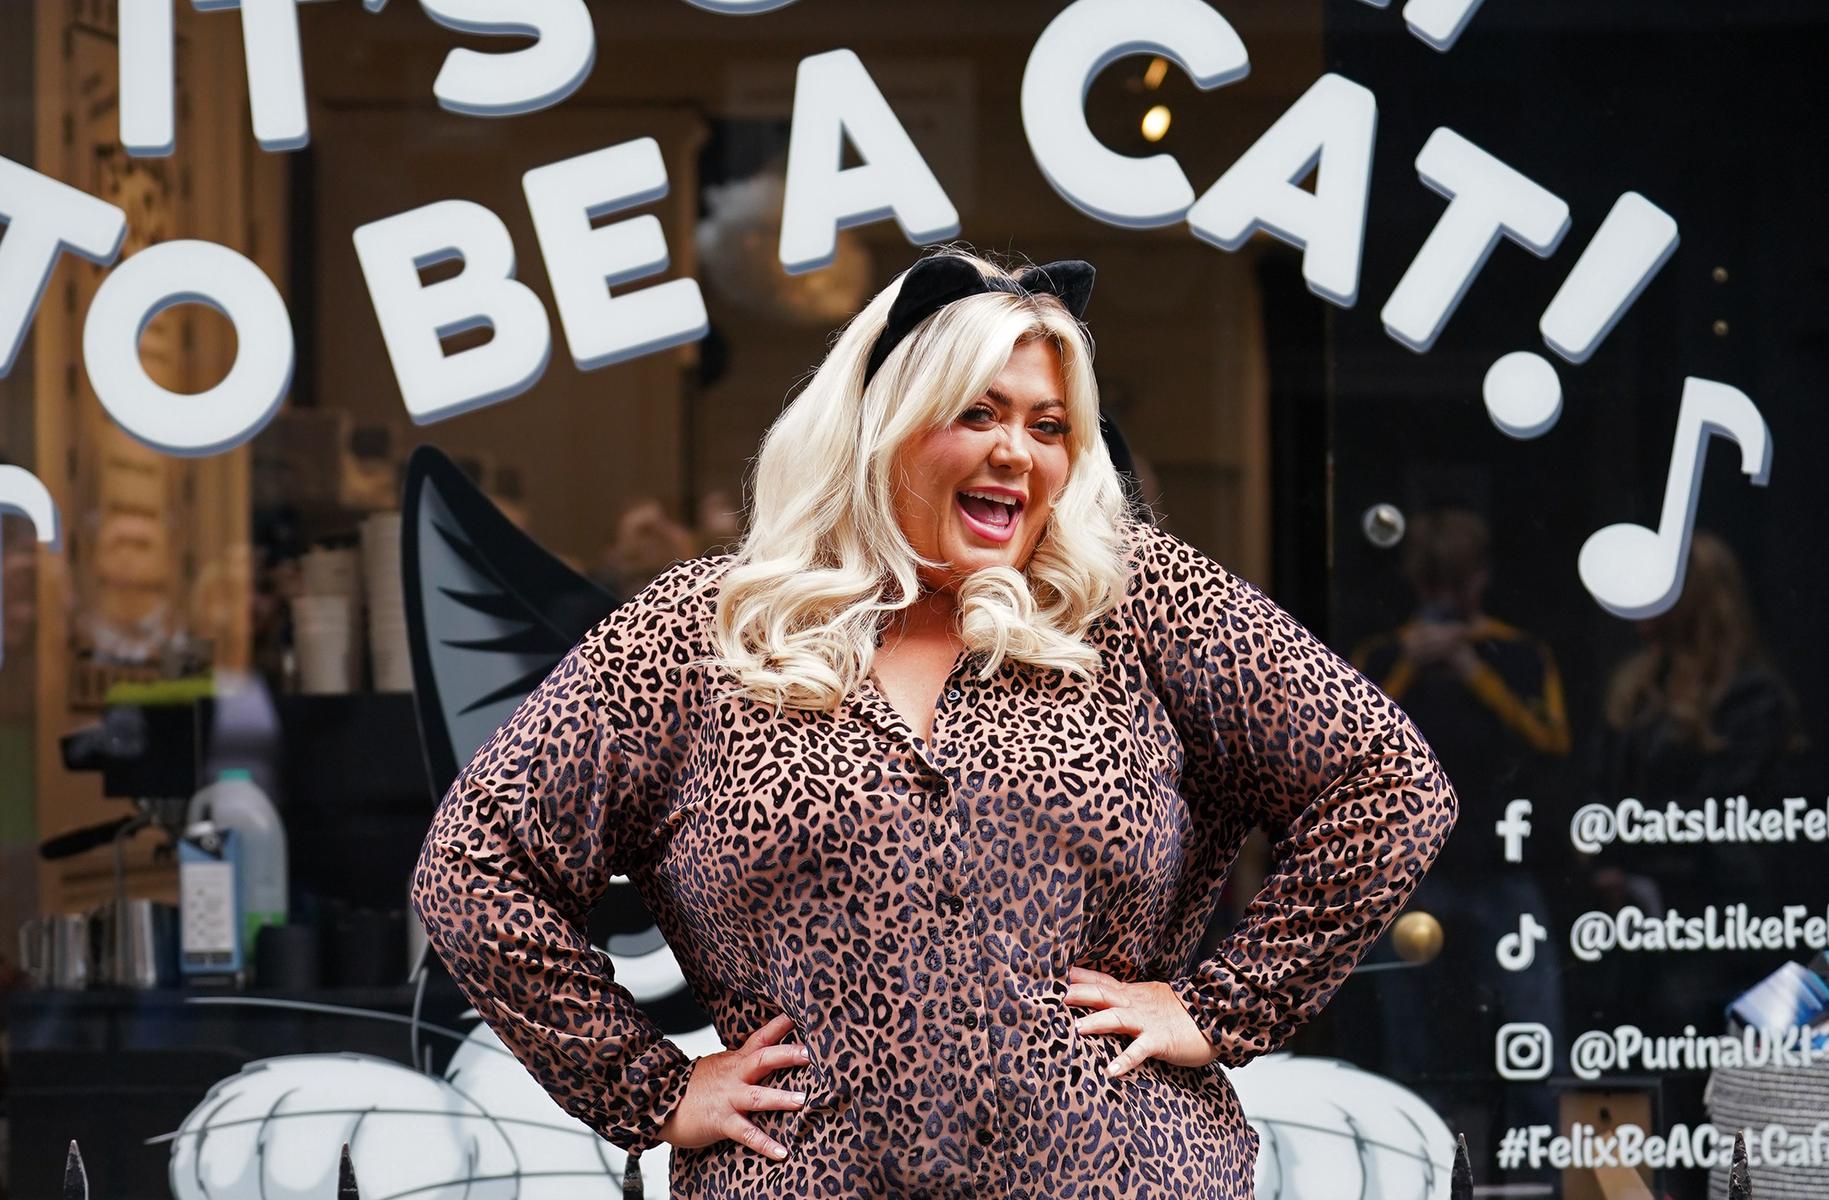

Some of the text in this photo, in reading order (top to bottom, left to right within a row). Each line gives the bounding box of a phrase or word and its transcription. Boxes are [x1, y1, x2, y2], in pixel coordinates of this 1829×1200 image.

[117, 0, 598, 157] ITS
[352, 136, 710, 427] BE
[778, 47, 962, 276] A
[1020, 0, 1680, 440] CAT!
[1569, 795, 1829, 855] @CatsLikeFe
[1569, 902, 1829, 962] @CatsLikeFe
[1569, 1023, 1813, 1081] @PurinaUKI
